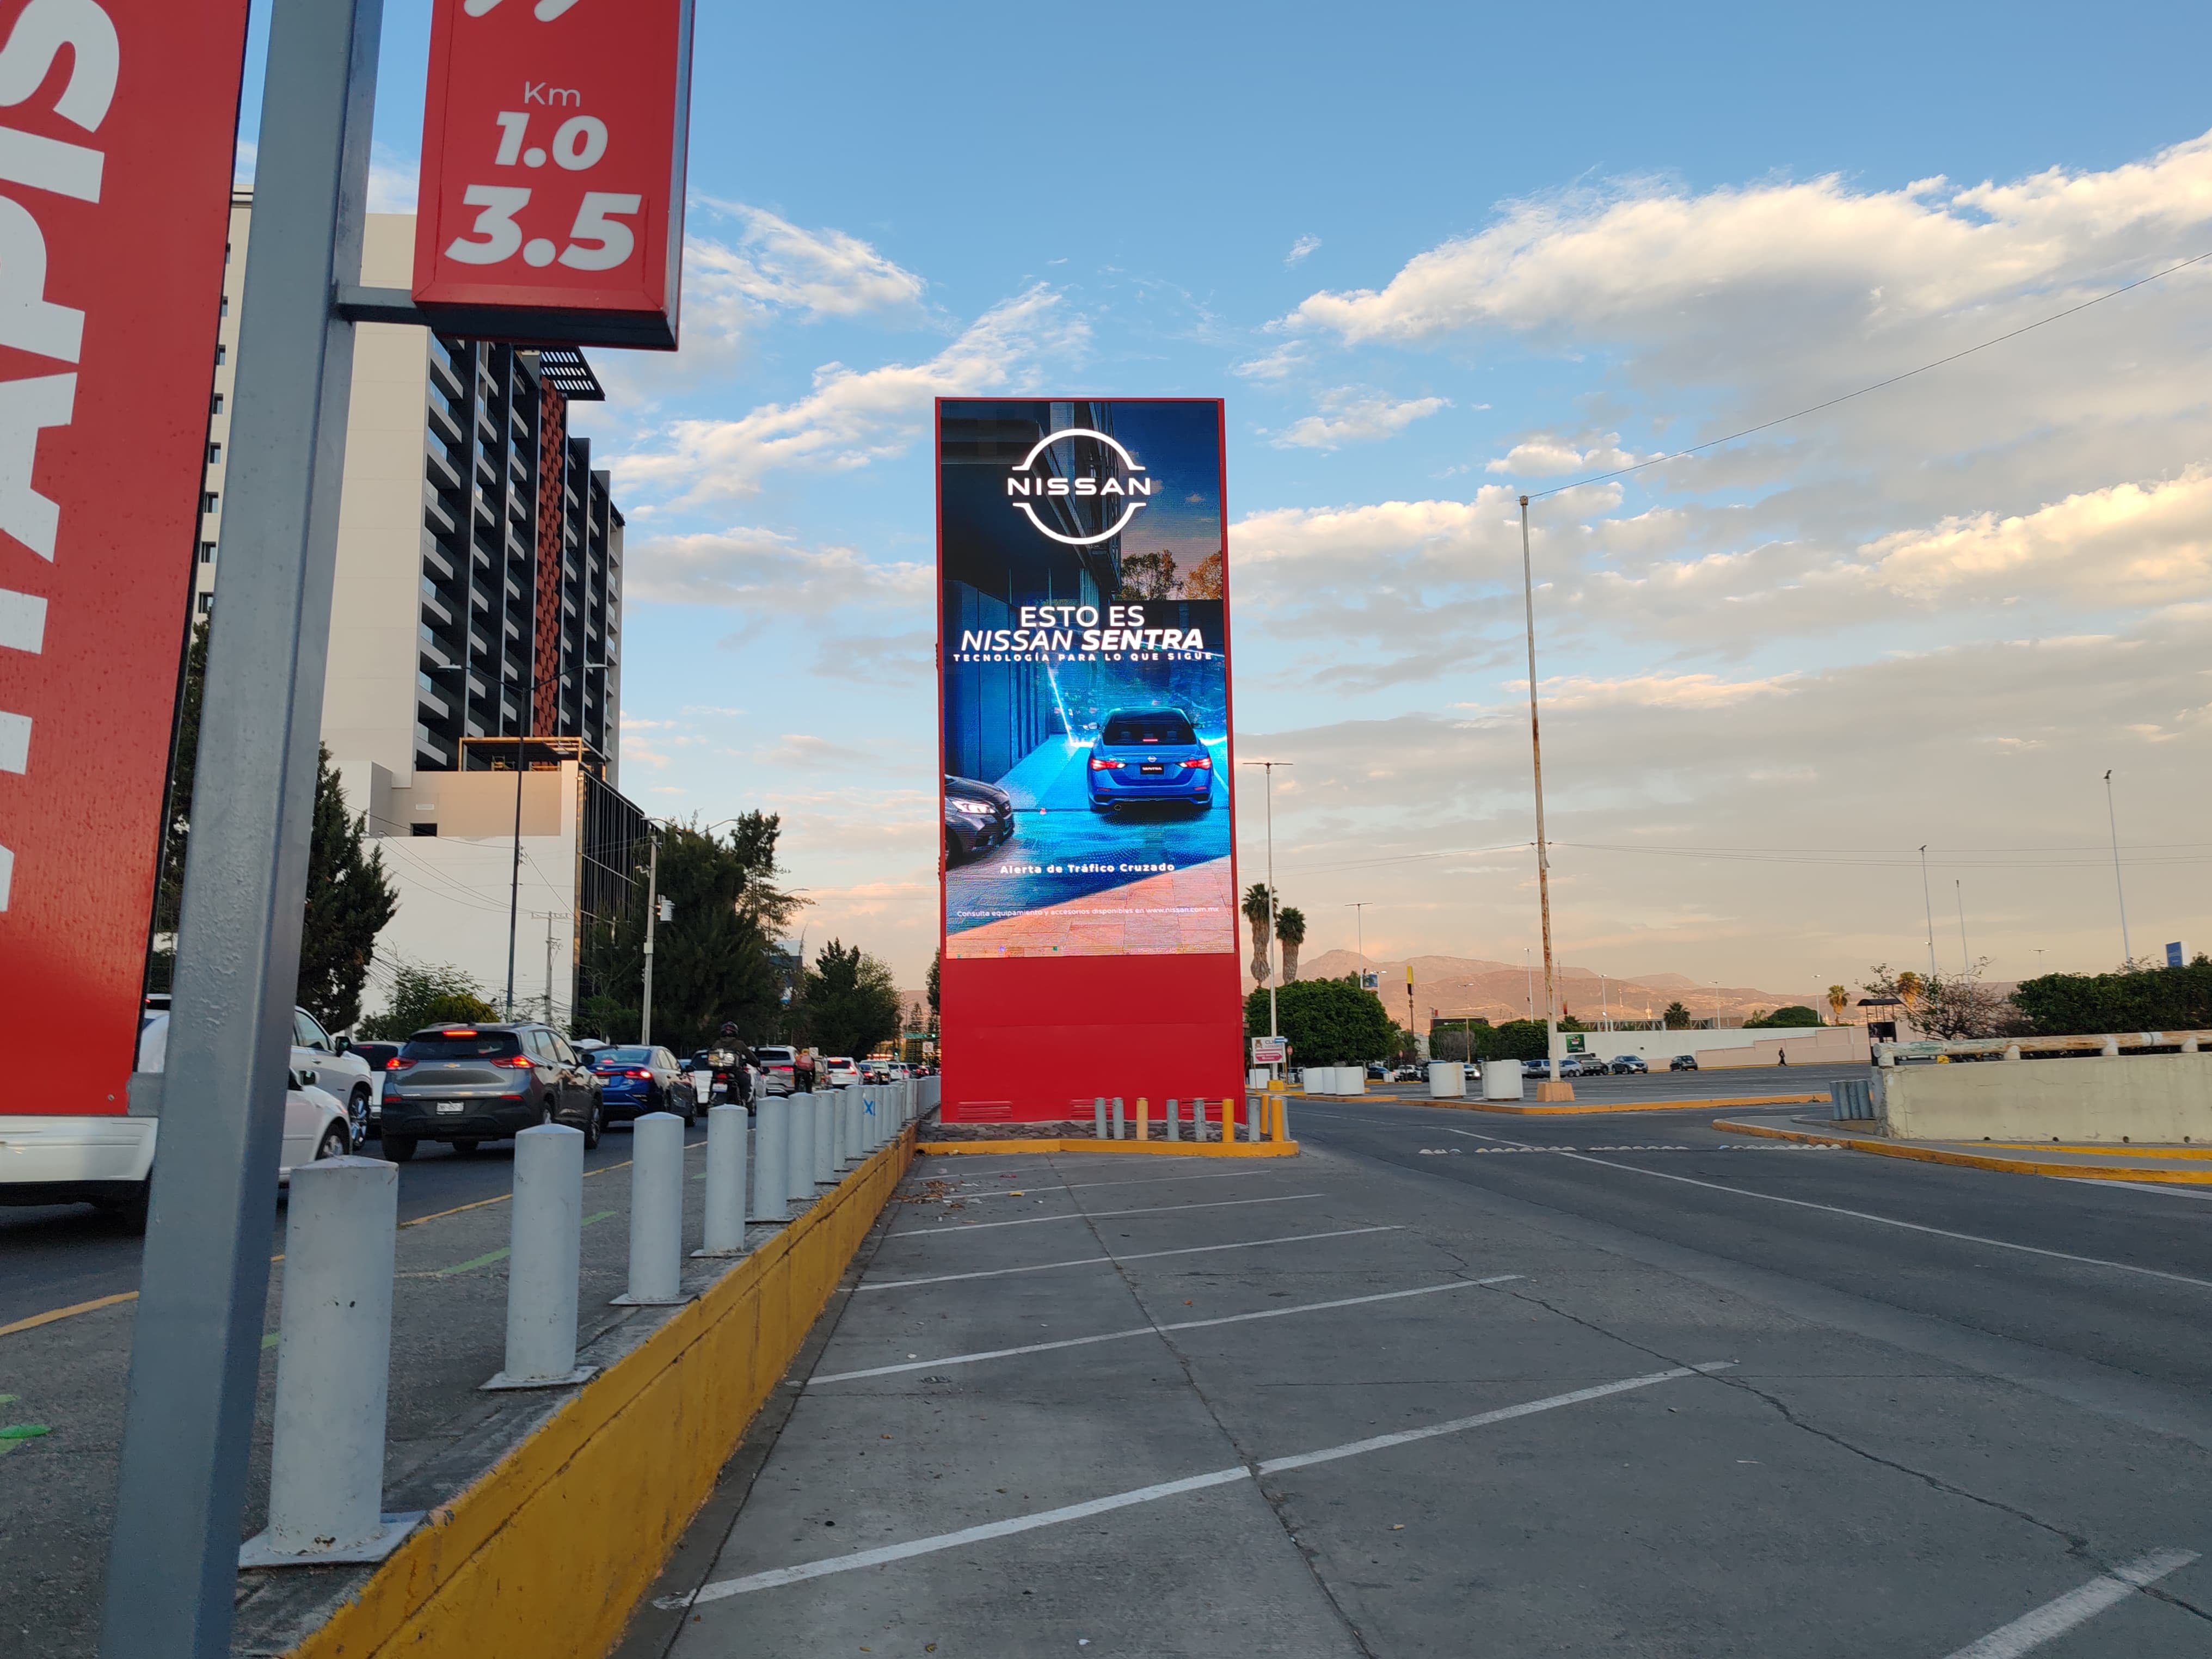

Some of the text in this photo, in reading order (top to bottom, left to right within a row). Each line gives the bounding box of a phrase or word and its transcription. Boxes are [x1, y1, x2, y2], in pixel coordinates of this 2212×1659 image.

[524, 81, 581, 107] Km
[494, 111, 609, 171] 1.0
[444, 184, 642, 271] 3.5
[1007, 477, 1151, 495] NISSAN
[1021, 605, 1145, 628] ESTO ES
[961, 628, 1204, 652] NISSAN SENTRA
[953, 652, 1212, 662] TECNOLOGÍA PARA LO QUE SIGUE
[999, 863, 1175, 874] Alerta de Tráfico Cruzado
[991, 909, 1043, 918] equipamiento
[1092, 907, 1134, 915] disponibles
